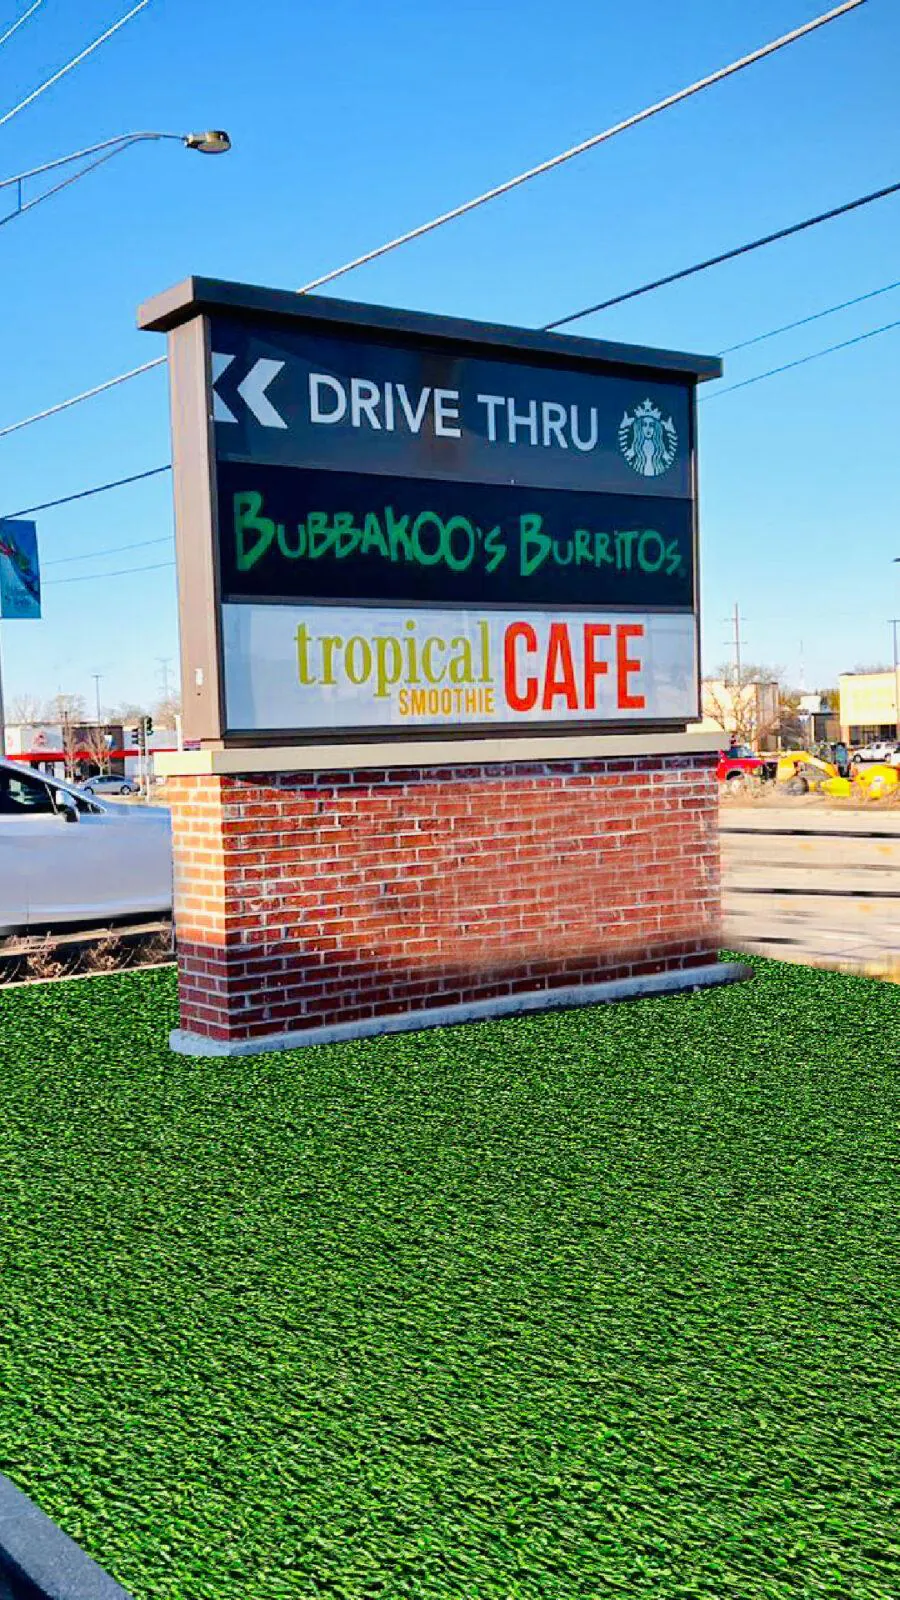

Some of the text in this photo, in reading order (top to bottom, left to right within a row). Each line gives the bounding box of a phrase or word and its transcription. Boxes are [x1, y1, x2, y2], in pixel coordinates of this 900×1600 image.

[309, 372, 599, 451] DRIVE THRU
[294, 620, 645, 711] tropical CAFE
[399, 688, 494, 716] SMOOTHIE
